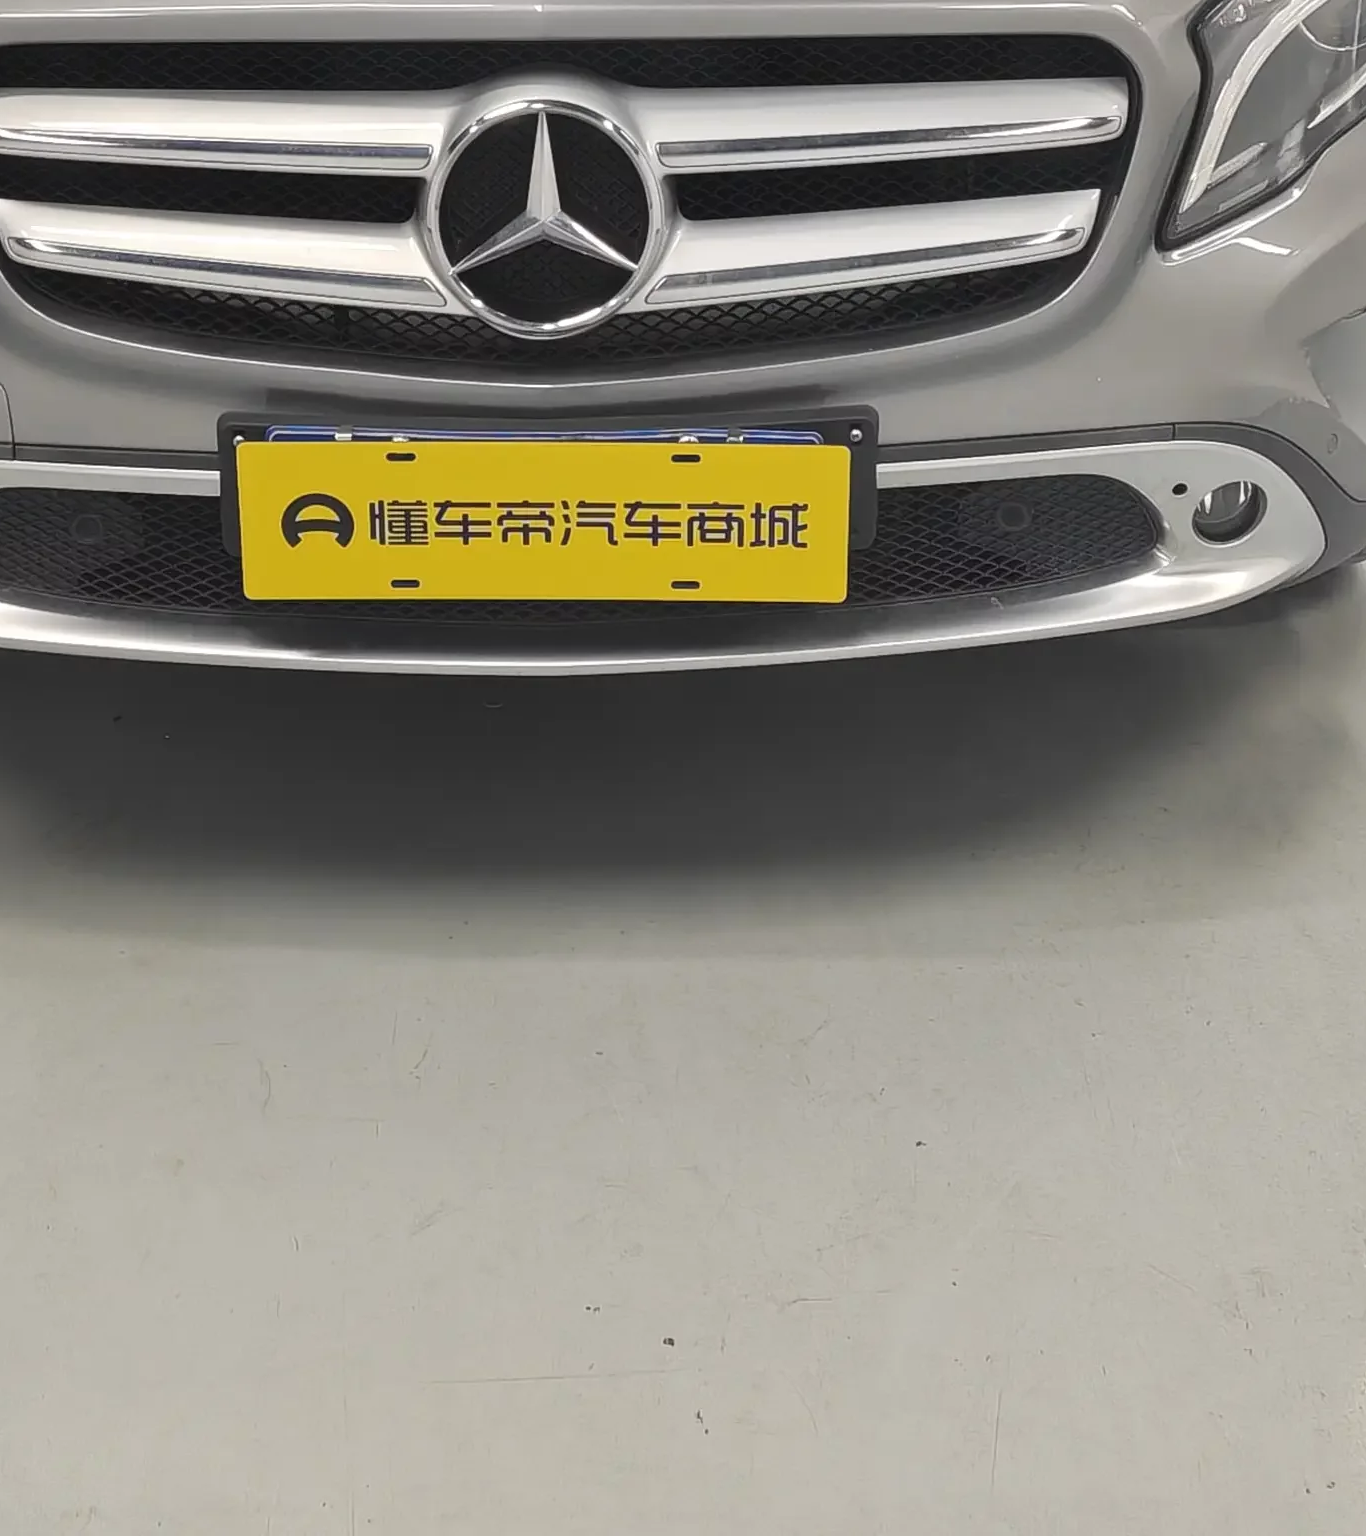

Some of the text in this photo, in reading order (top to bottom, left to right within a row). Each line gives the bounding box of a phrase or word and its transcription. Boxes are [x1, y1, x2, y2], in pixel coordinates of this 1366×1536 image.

[368, 499, 810, 549] 懂车帝汽车商城
